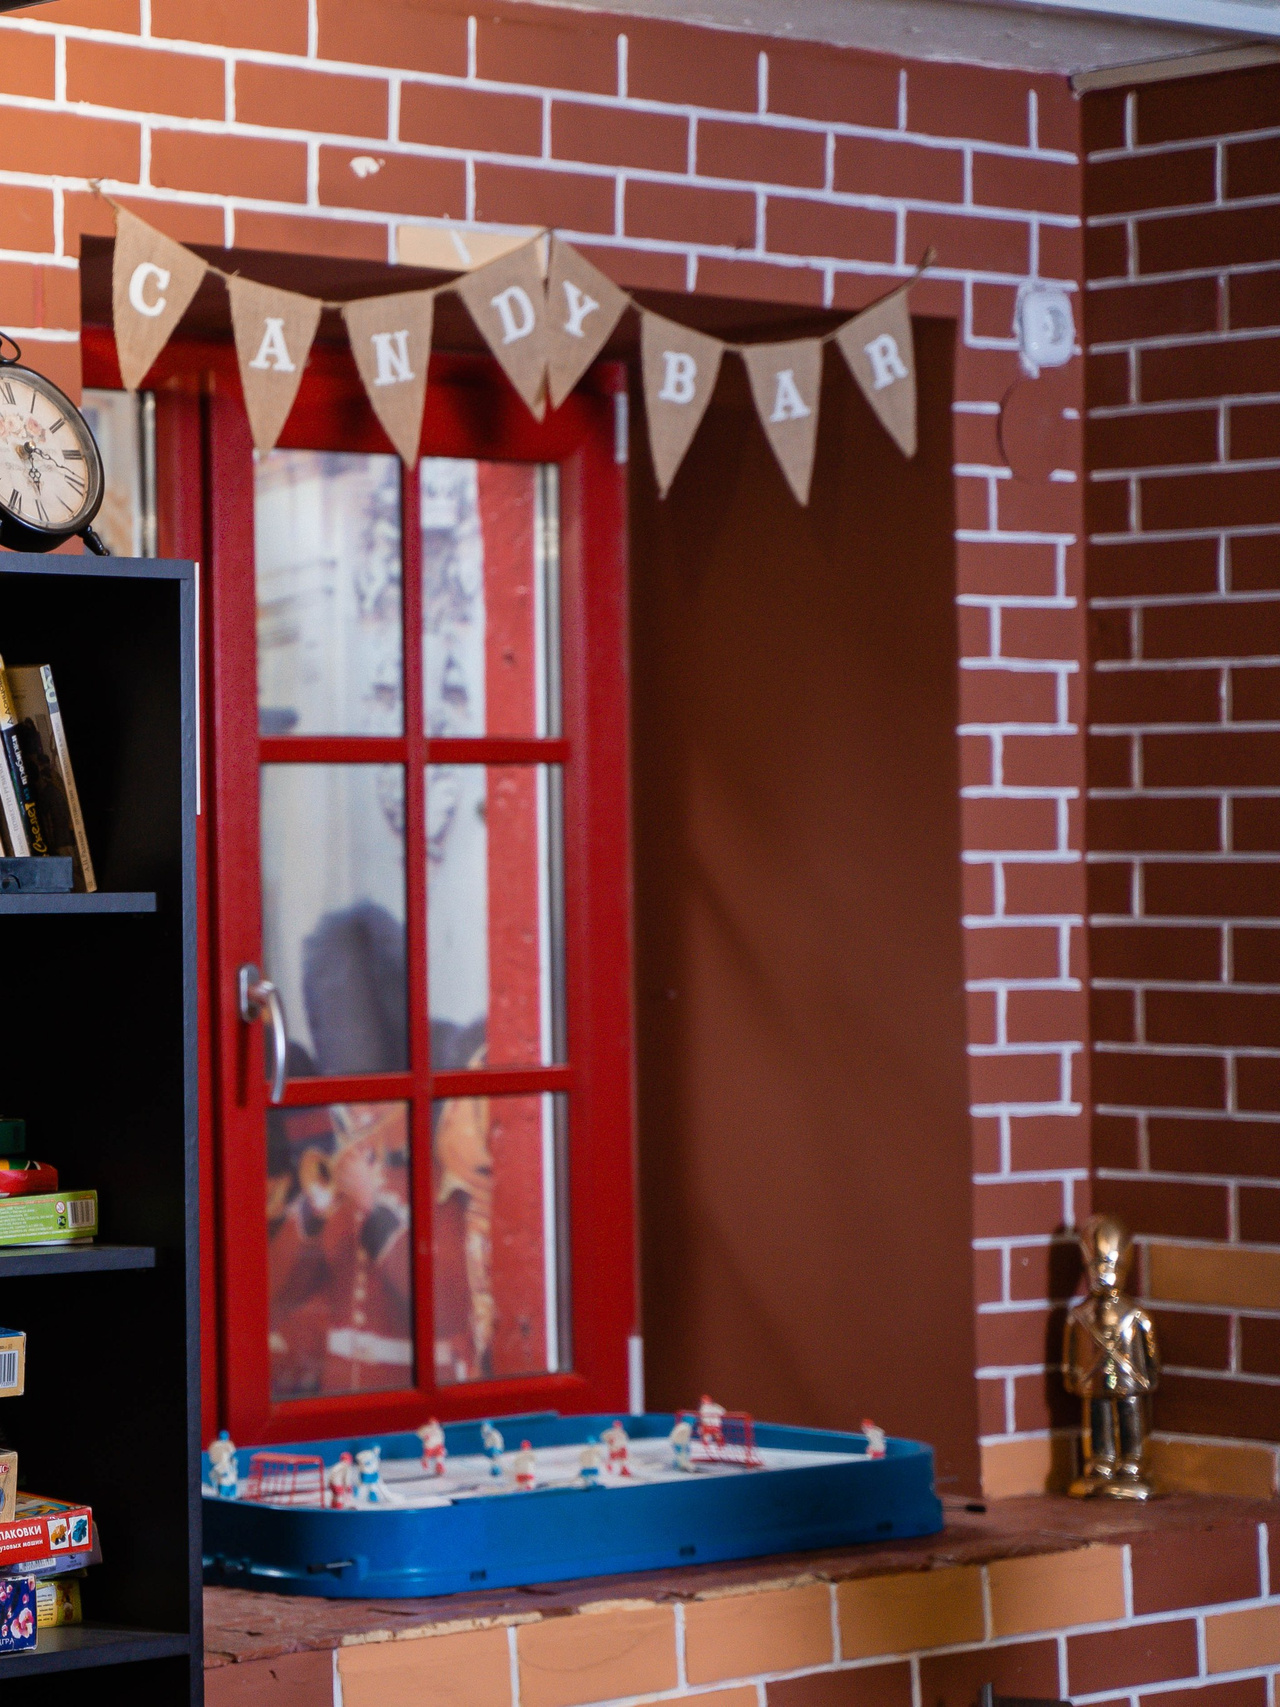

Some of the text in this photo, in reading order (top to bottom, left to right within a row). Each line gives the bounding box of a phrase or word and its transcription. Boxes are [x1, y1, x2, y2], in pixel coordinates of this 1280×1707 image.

[127, 259, 598, 387] CANDY
[660, 328, 911, 424] BAR
[24, 802, 48, 853] Скелет
[22, 1538, 43, 1548] машин
